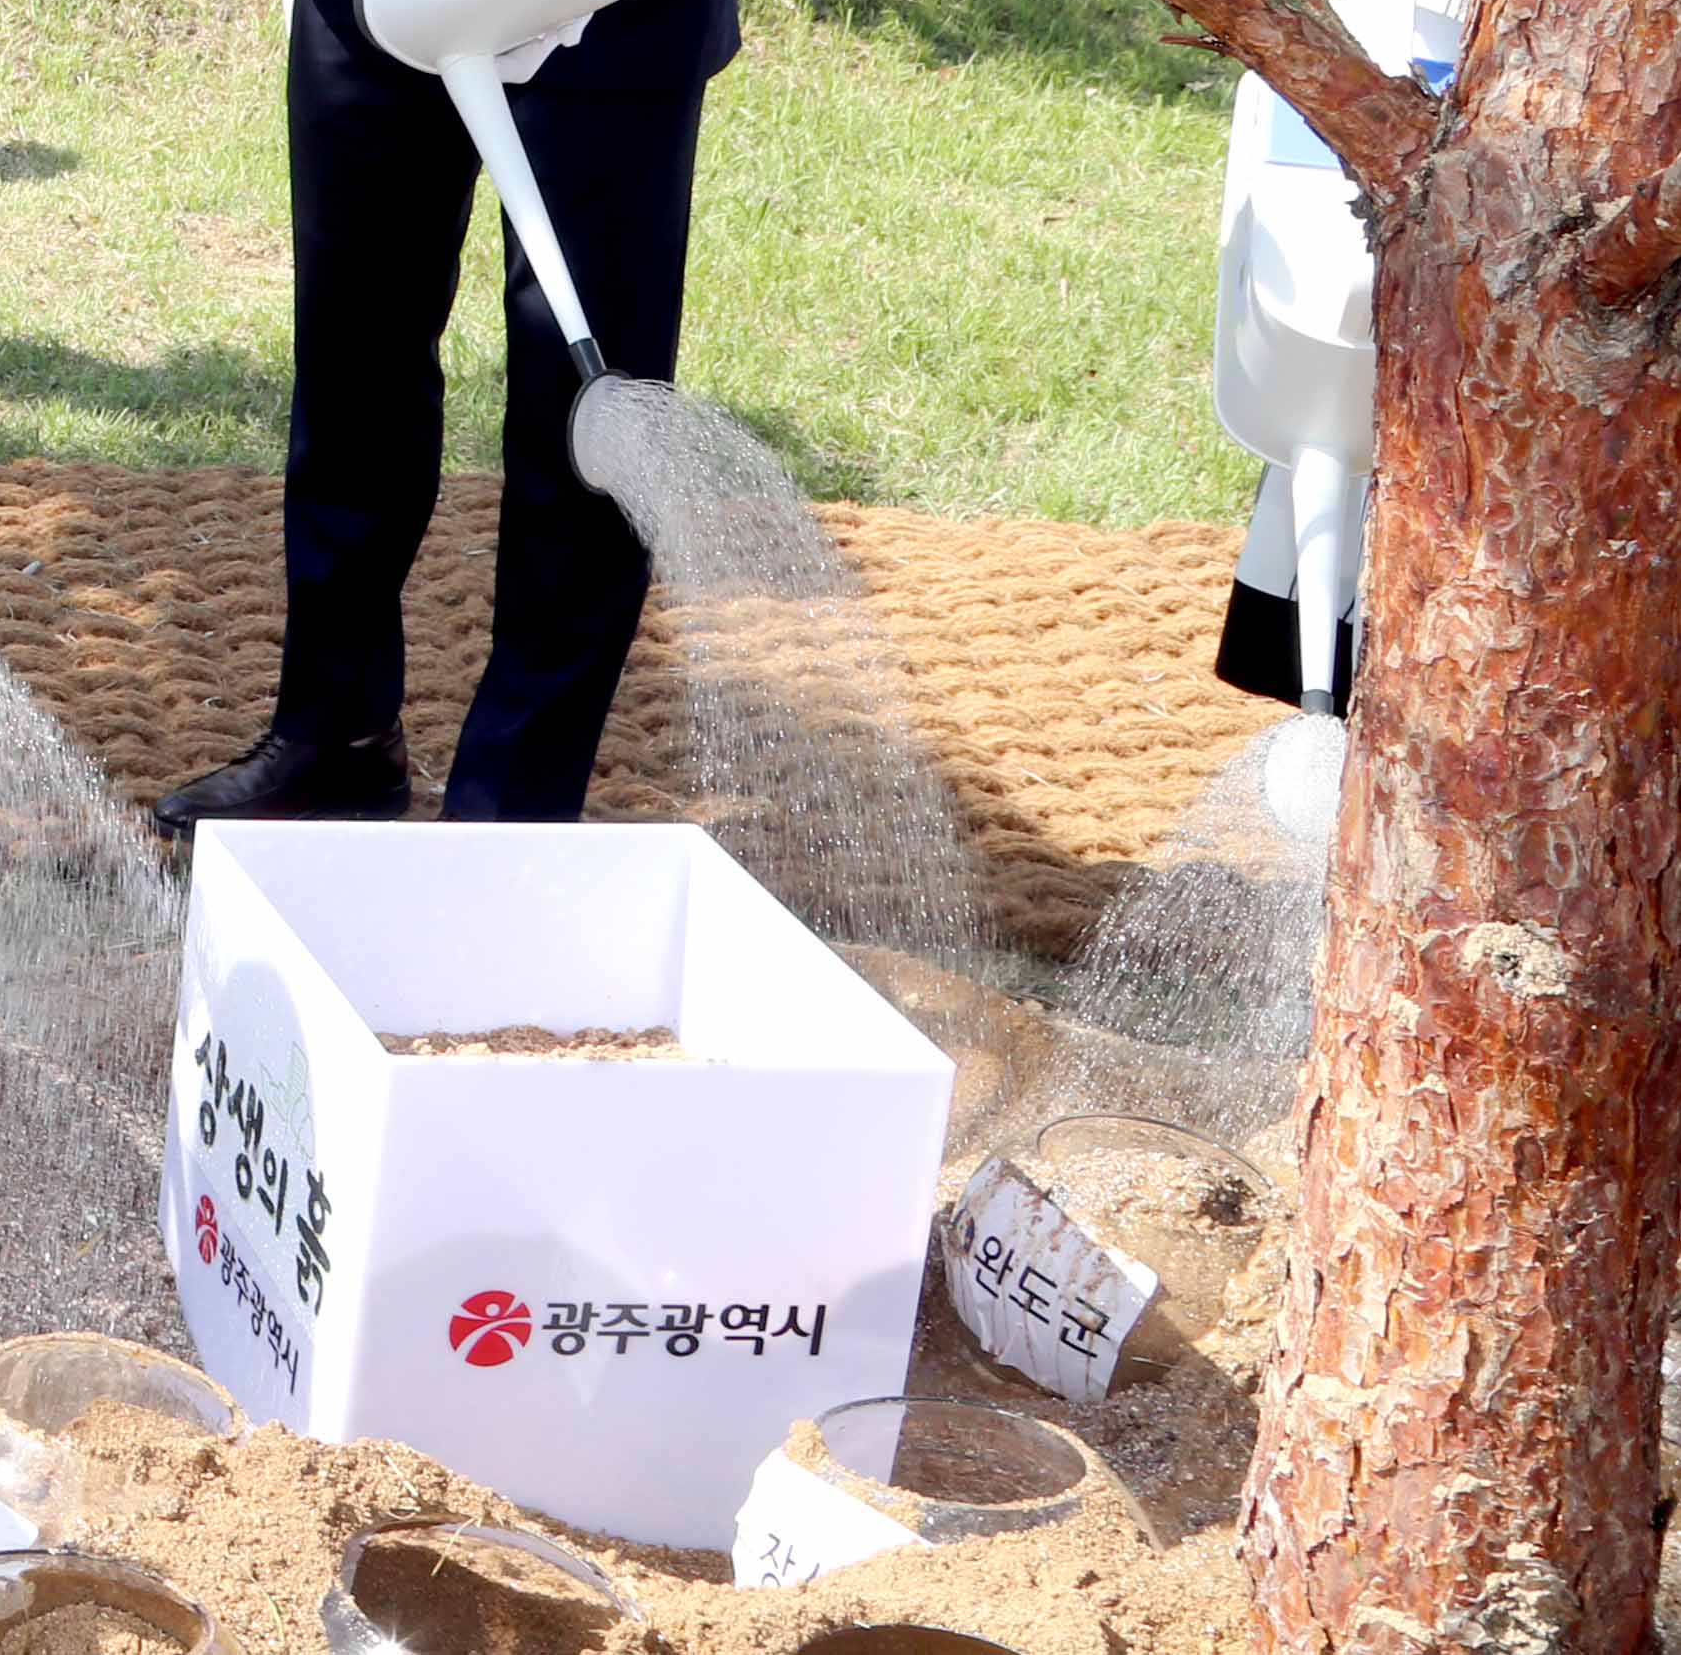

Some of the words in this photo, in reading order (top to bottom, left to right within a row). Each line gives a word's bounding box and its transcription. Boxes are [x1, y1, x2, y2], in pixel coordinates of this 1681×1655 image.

[194, 1030, 289, 1237] 상생의
[294, 1167, 332, 1317] 흙
[220, 1232, 300, 1396] 광주광역시
[541, 1301, 827, 1357] 광주광역시
[974, 1236, 1111, 1359] 완도군
